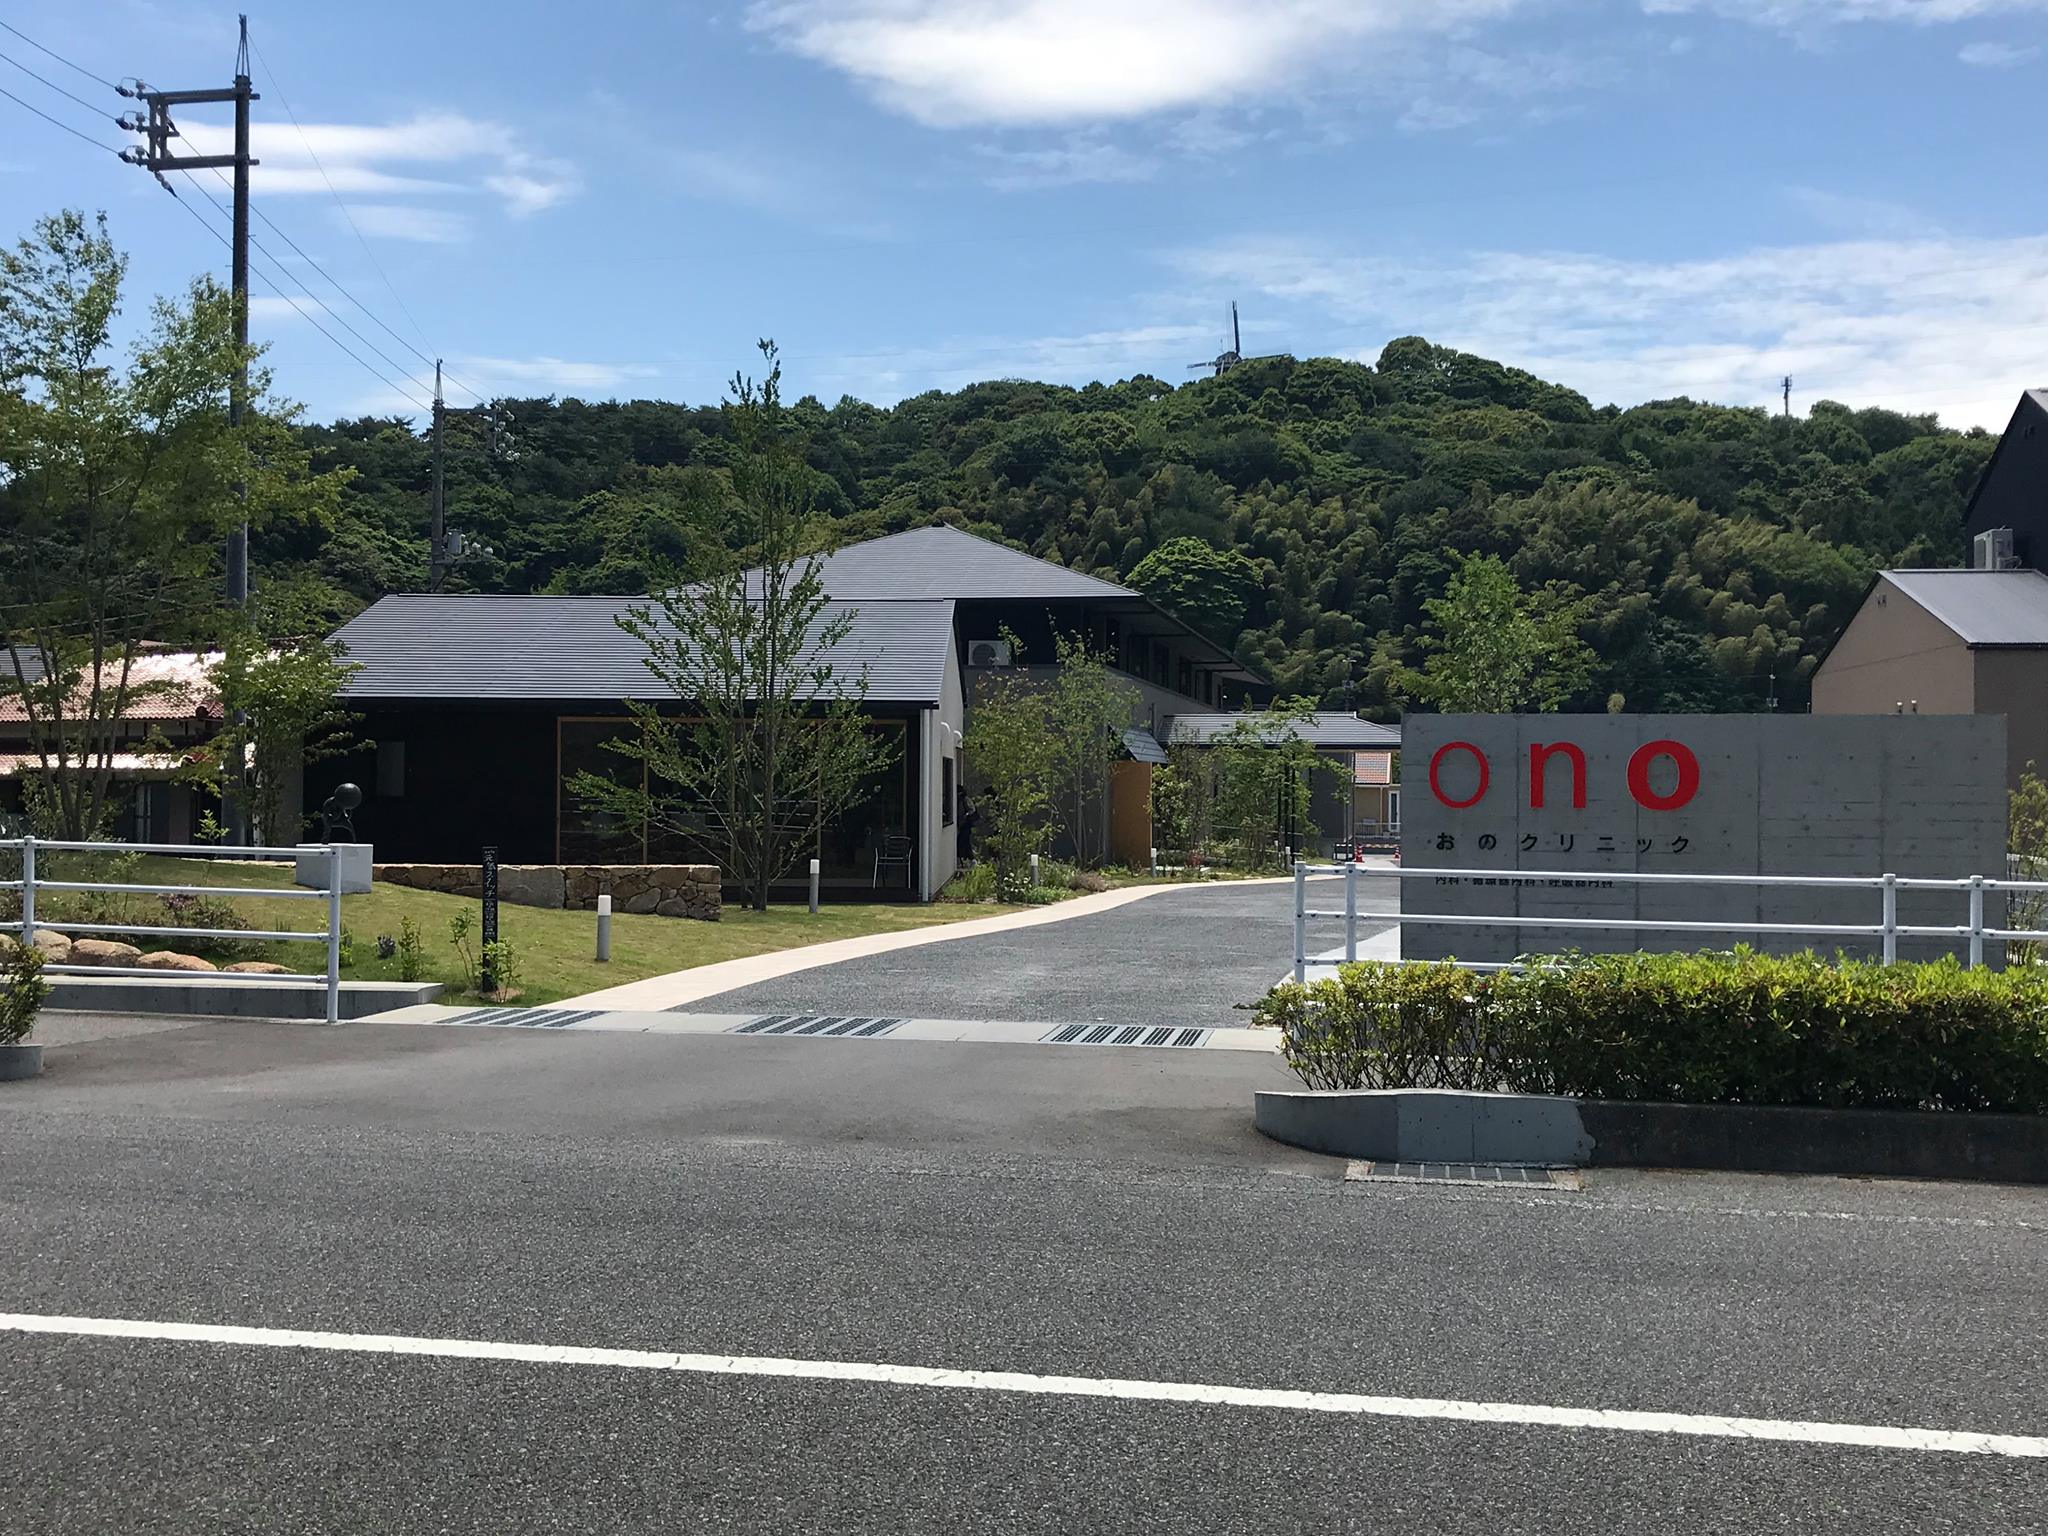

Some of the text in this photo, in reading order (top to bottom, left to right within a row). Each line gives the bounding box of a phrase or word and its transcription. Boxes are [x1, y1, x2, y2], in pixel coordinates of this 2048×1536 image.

[1429, 739, 1700, 811] ono
[1436, 832, 1690, 853] おのクリニック
